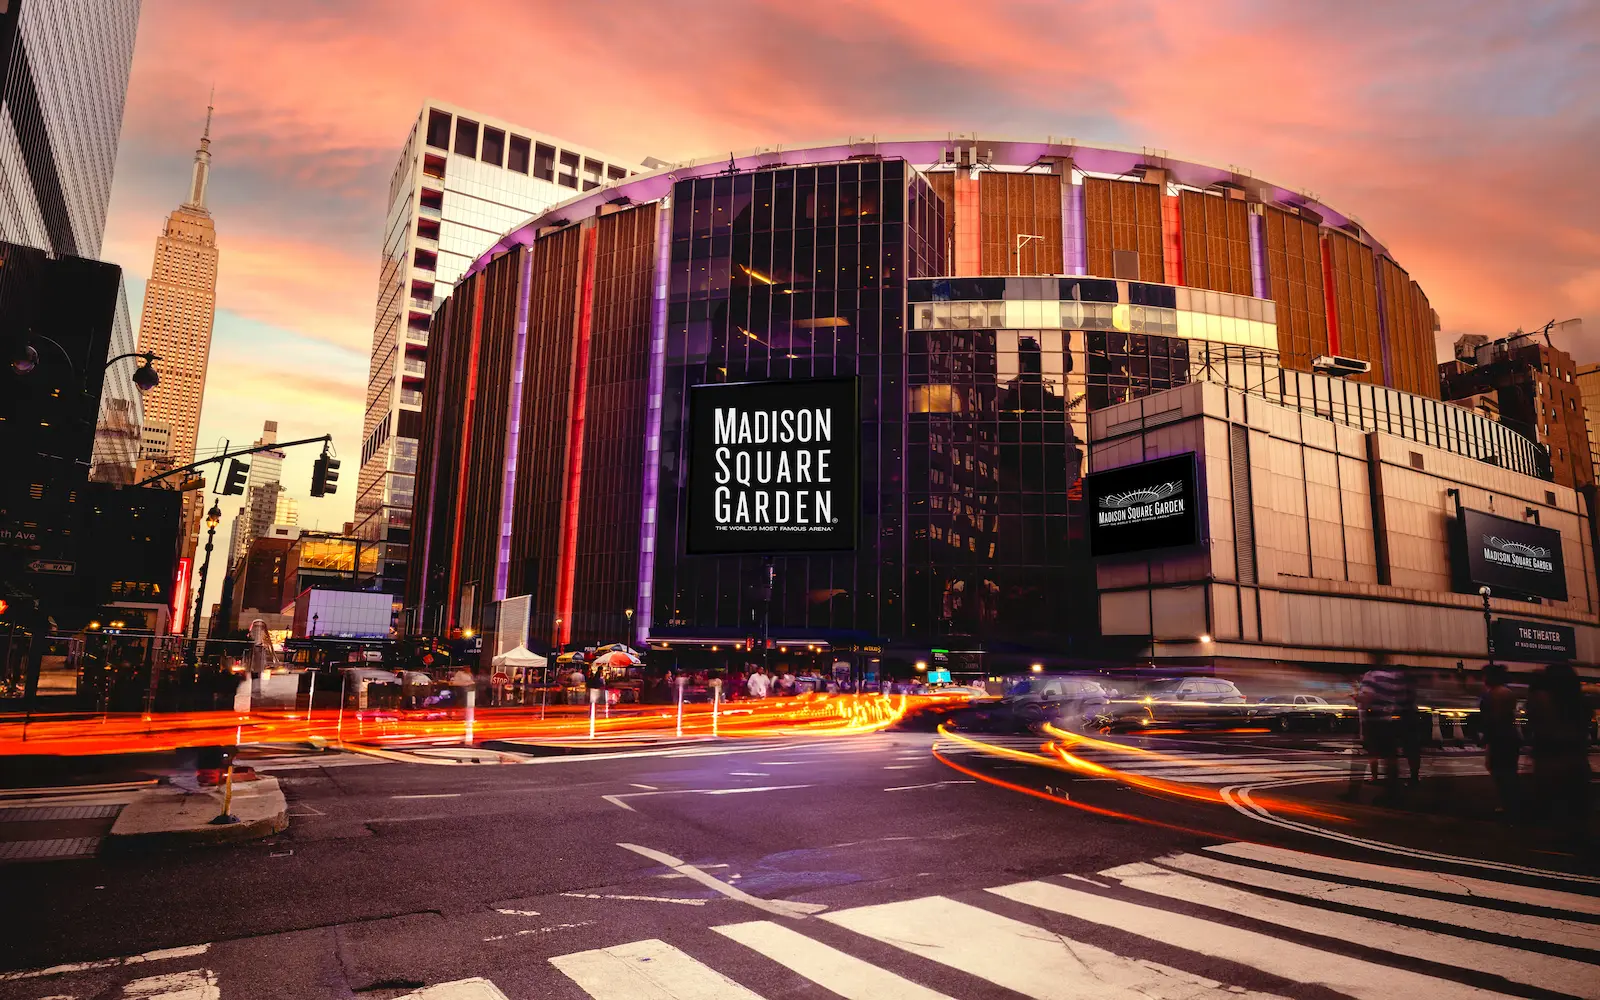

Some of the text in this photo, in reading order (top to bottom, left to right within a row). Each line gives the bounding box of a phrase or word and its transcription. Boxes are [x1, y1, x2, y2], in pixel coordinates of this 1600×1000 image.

[714, 408, 832, 444] MADISON
[714, 447, 832, 486] SQUARE
[1099, 498, 1184, 524] MADISON SQUARE GARDEN
[0, 529, 36, 540] th Ave
[1484, 548, 1511, 563] MADISON
[1511, 553, 1532, 567] SQUARE
[1533, 558, 1553, 570] GARDEN
[1518, 627, 1560, 642] THE THEATER
[492, 677, 508, 685] STOP
